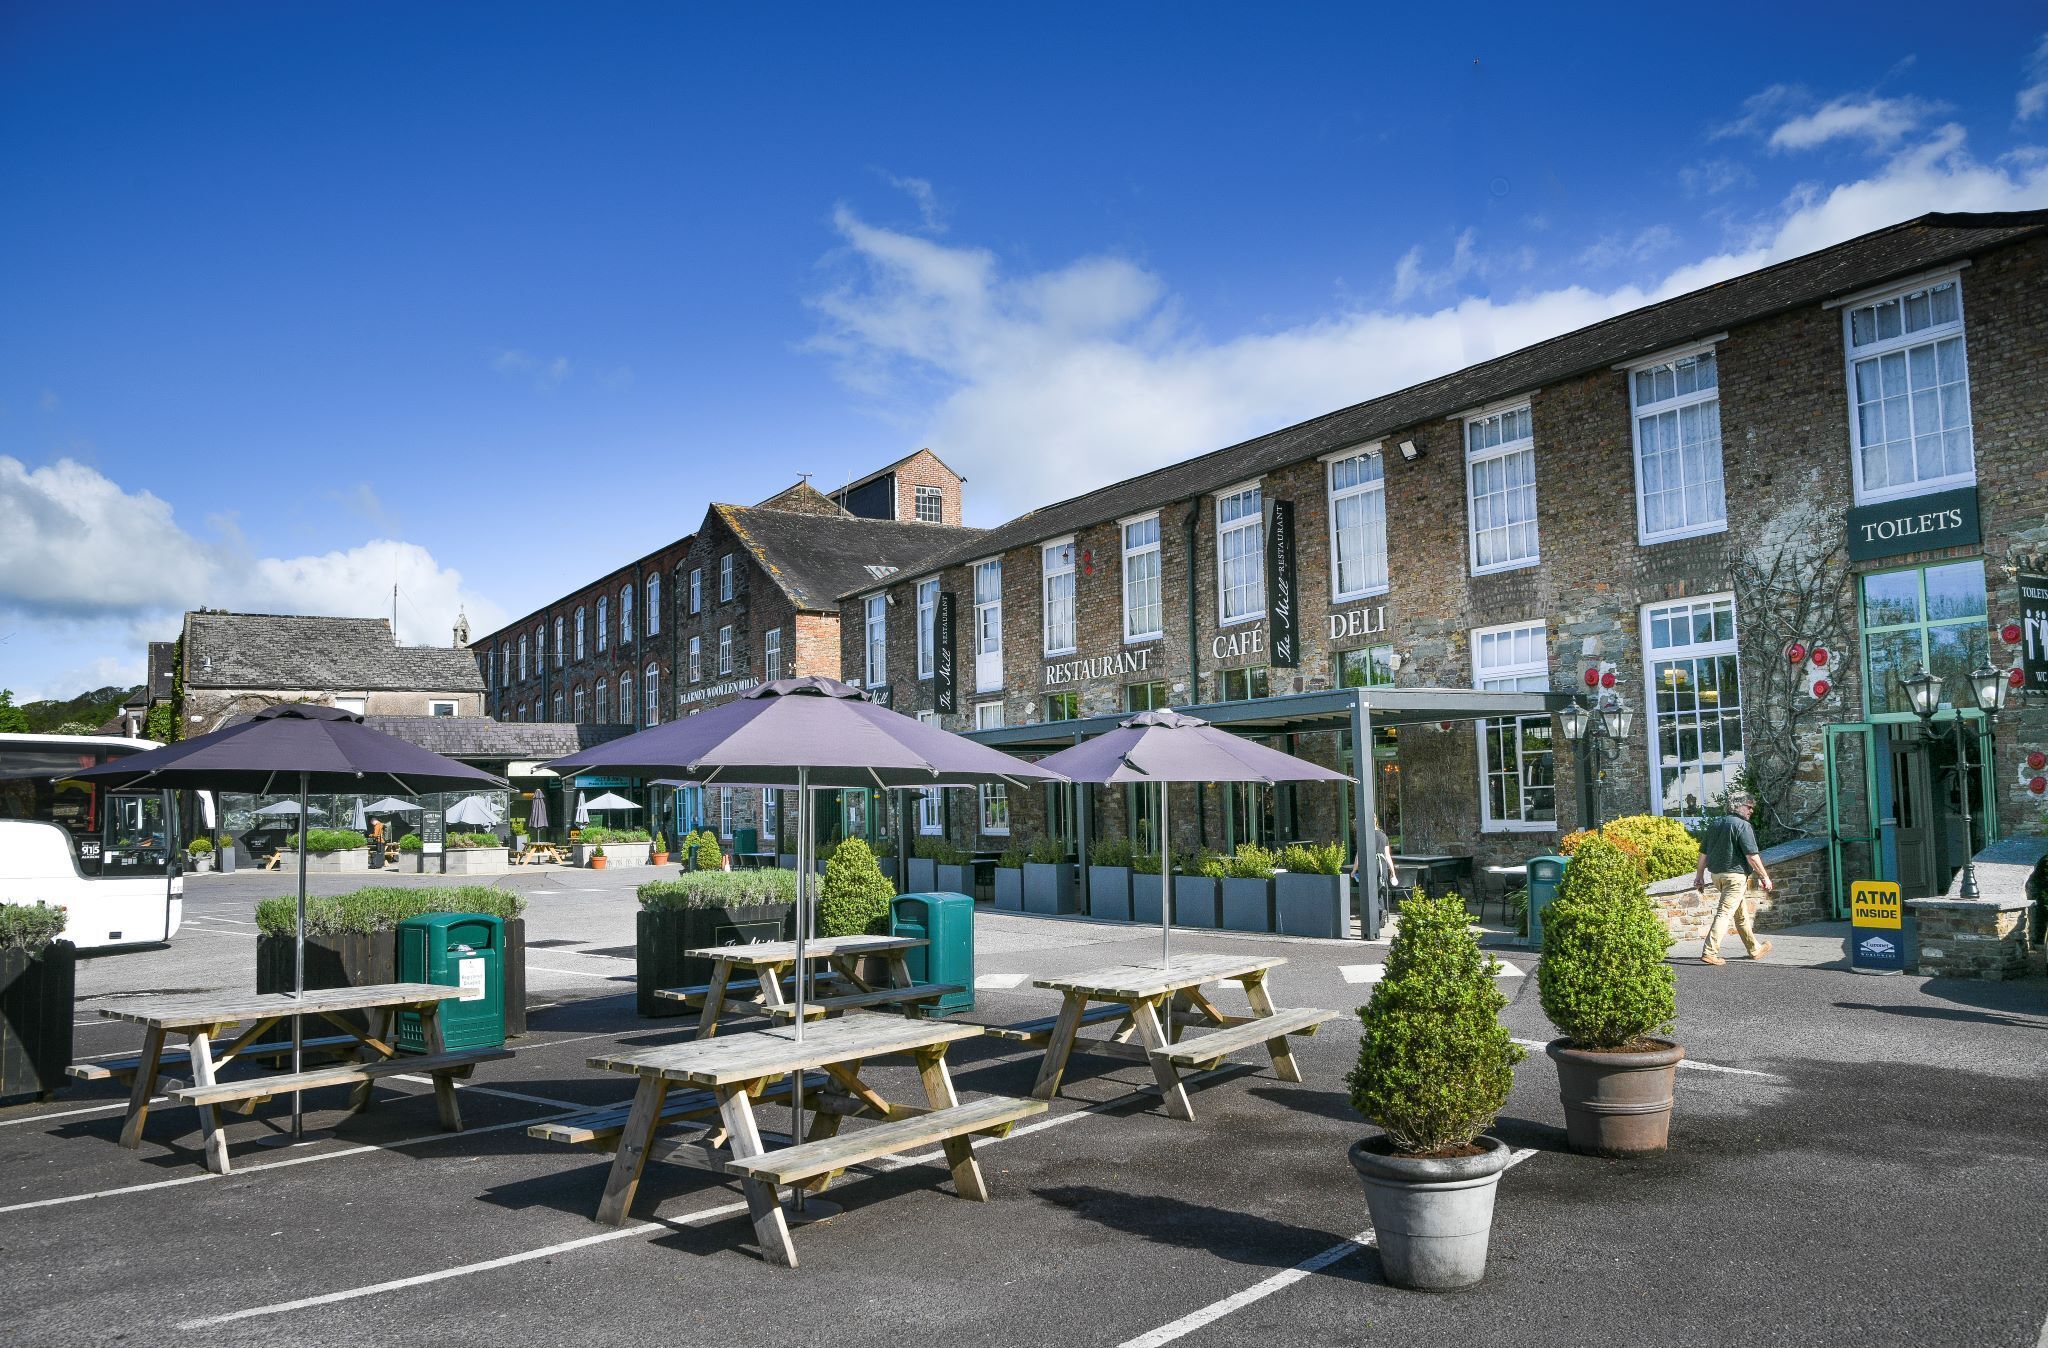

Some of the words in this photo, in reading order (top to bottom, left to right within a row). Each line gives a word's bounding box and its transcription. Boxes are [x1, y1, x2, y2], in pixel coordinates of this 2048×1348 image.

[1276, 504, 1286, 573] RESTAURANT
[1861, 508, 1963, 542] TOILETS
[1275, 576, 1290, 629] Mill
[2021, 586, 2048, 600] TOILETS
[1328, 606, 1386, 640] DELI
[1212, 621, 1264, 659] CAFÉ
[1276, 633, 1291, 663] The
[939, 647, 951, 686] Mill
[1045, 648, 1151, 685] RESTAURANT
[2035, 671, 2048, 682] WC
[706, 681, 738, 698] WOOLLEN
[739, 676, 760, 691] MILLS
[939, 688, 951, 710] The
[1855, 890, 1897, 906] ATM
[1856, 908, 1898, 919] INSIDE
